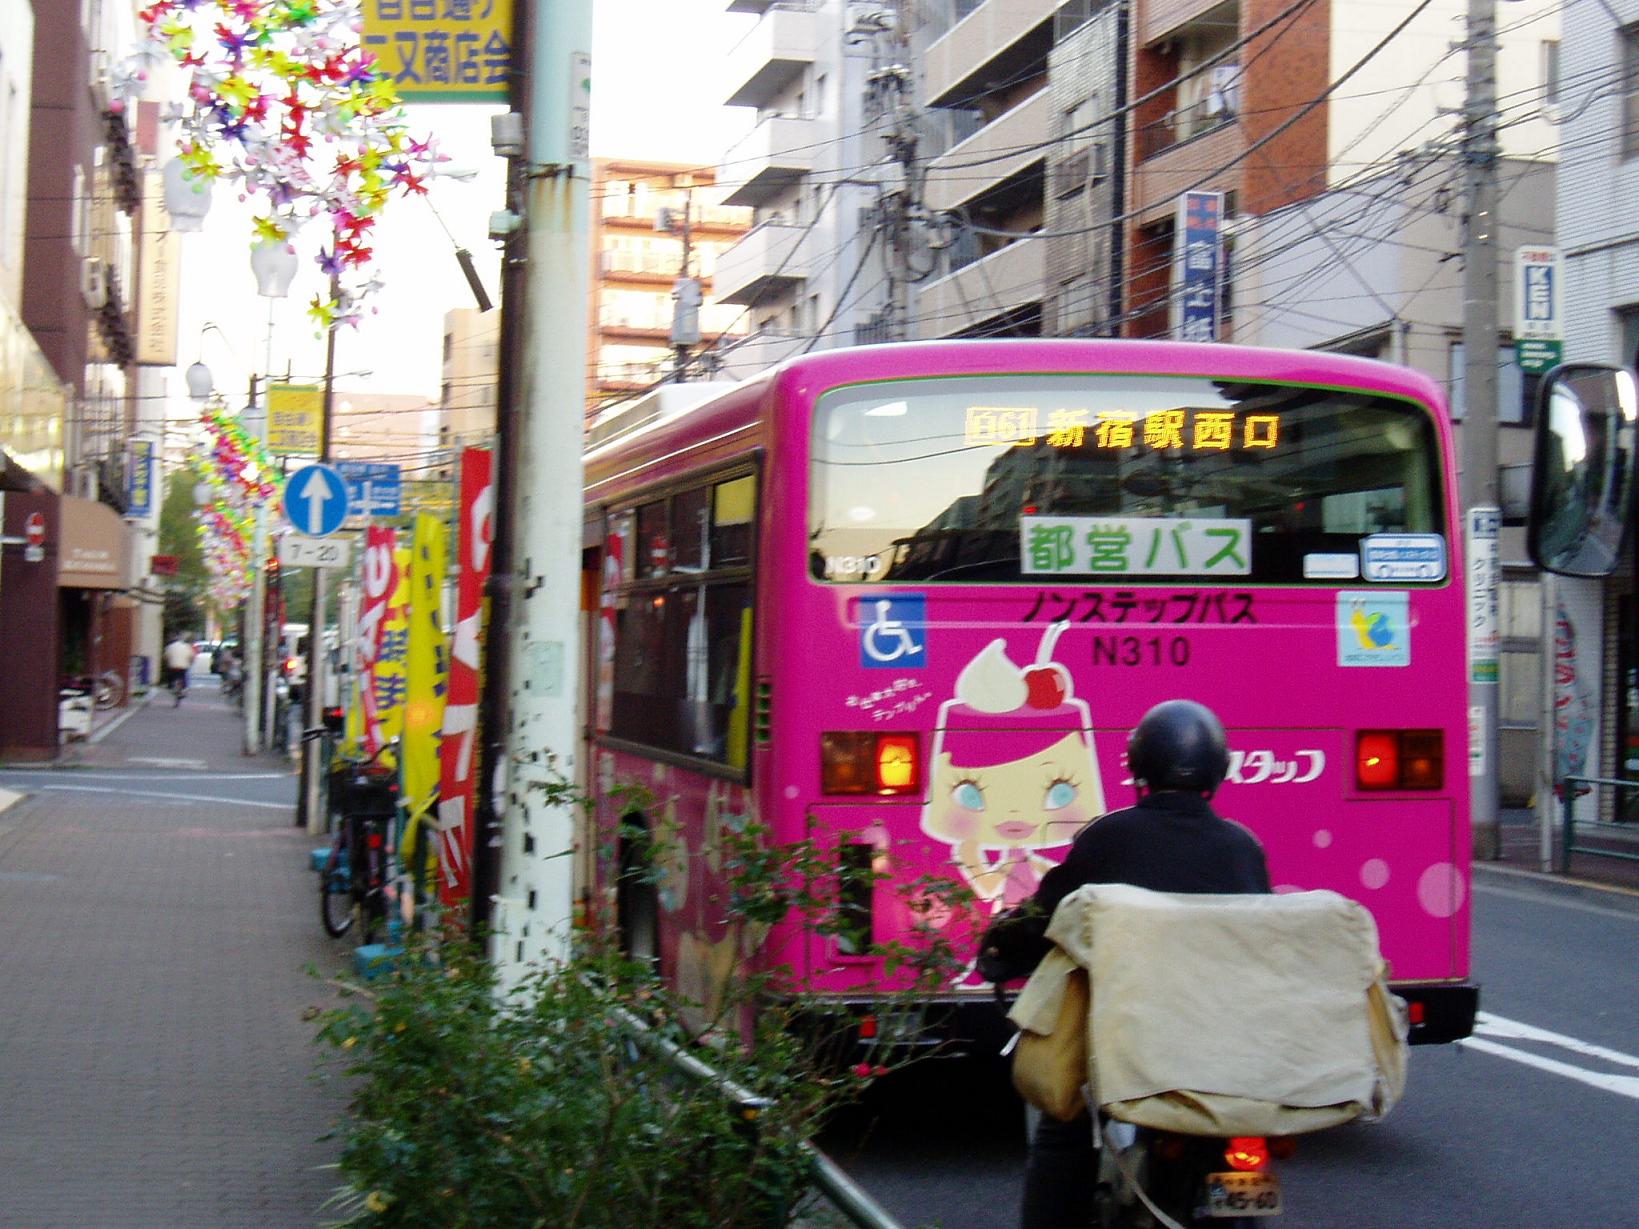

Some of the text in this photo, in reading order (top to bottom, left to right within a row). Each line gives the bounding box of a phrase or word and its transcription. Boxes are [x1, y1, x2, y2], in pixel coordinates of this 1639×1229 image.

[1047, 408, 1279, 450] 新宿駅西口
[1029, 521, 1246, 571] 都営バス
[1023, 591, 1259, 624] ノンステップバス
[1092, 636, 1191, 667] N310
